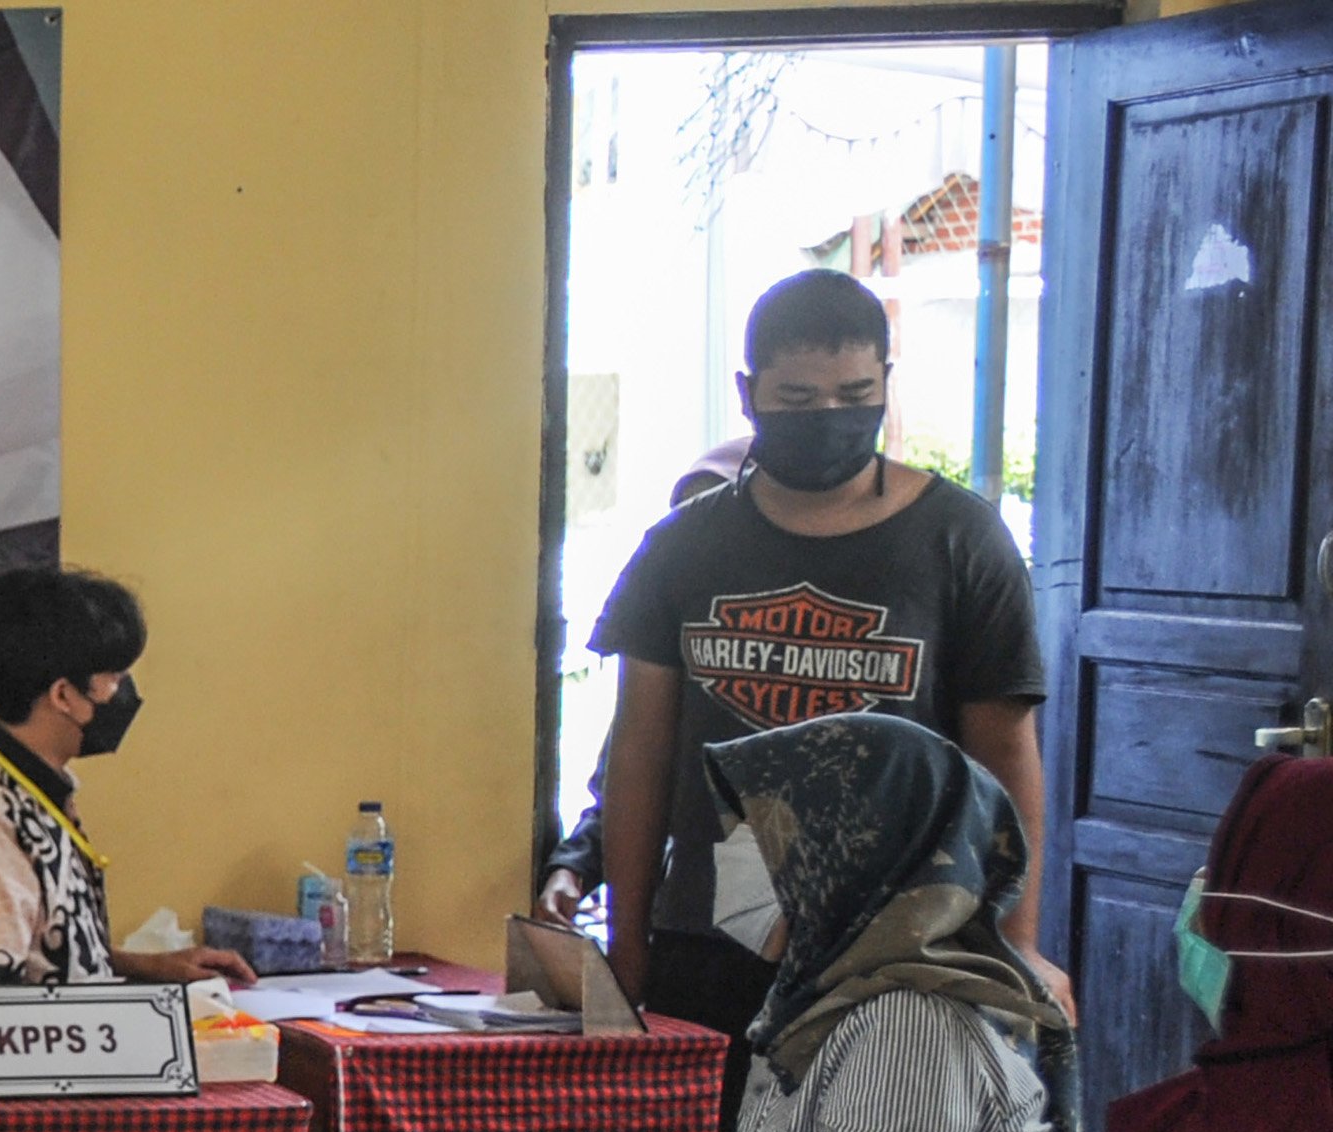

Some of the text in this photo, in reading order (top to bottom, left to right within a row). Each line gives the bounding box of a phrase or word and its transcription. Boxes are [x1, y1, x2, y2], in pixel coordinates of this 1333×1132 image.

[738, 601, 856, 639] MOTOR
[689, 636, 901, 685] HARLEY-DAVIDSON
[732, 679, 845, 723] CYCLES
[99, 1022, 118, 1054] 3
